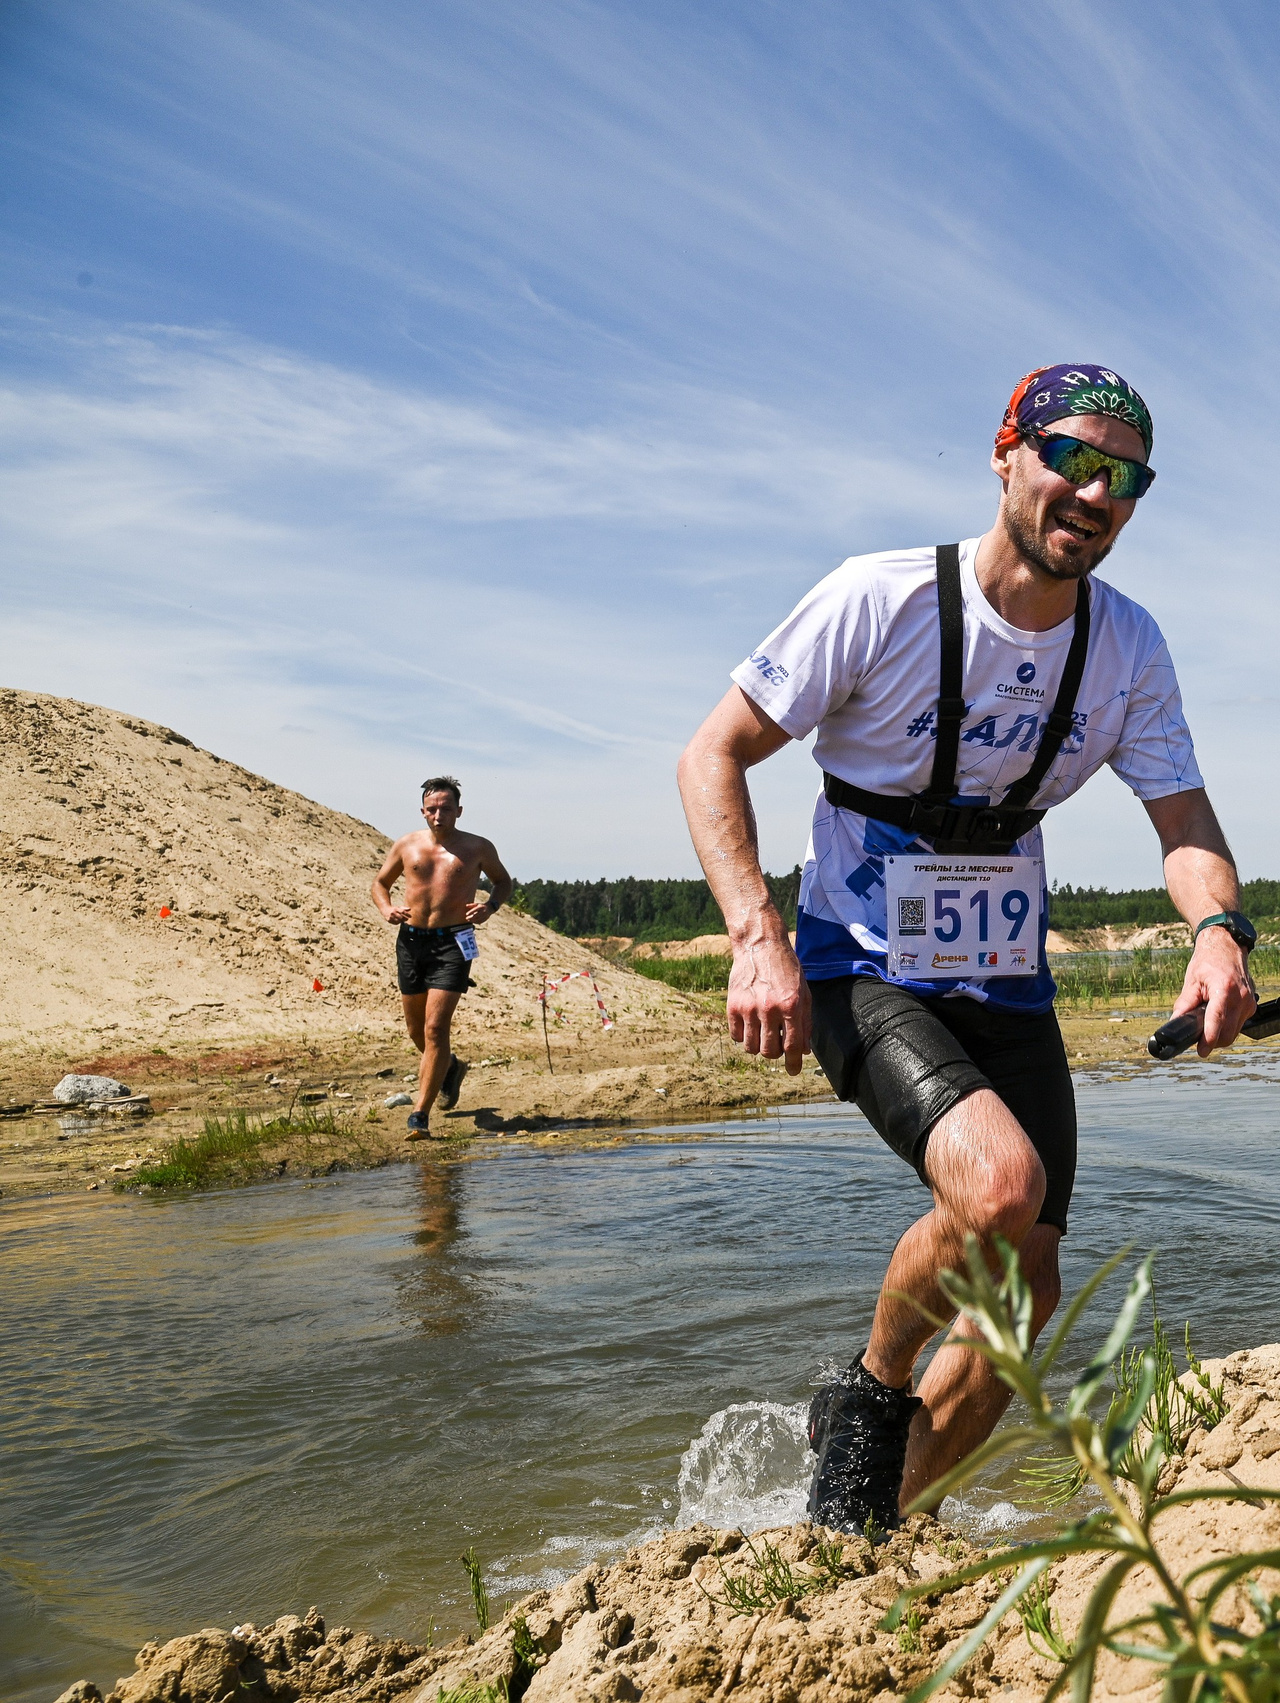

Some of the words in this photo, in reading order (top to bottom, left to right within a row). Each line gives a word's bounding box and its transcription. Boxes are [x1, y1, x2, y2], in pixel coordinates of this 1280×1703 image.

[749, 651, 785, 686] ЛЕС
[776, 664, 789, 677] 2023
[996, 683, 1045, 698] СИСТЕМА
[1070, 711, 1088, 726] 23
[913, 863, 952, 873] ТРЕЙЛЫ
[954, 865, 967, 873] 12
[968, 865, 1014, 873] МЕСЯЦЕВ
[933, 889, 1030, 943] 519
[932, 952, 969, 964] Арена
